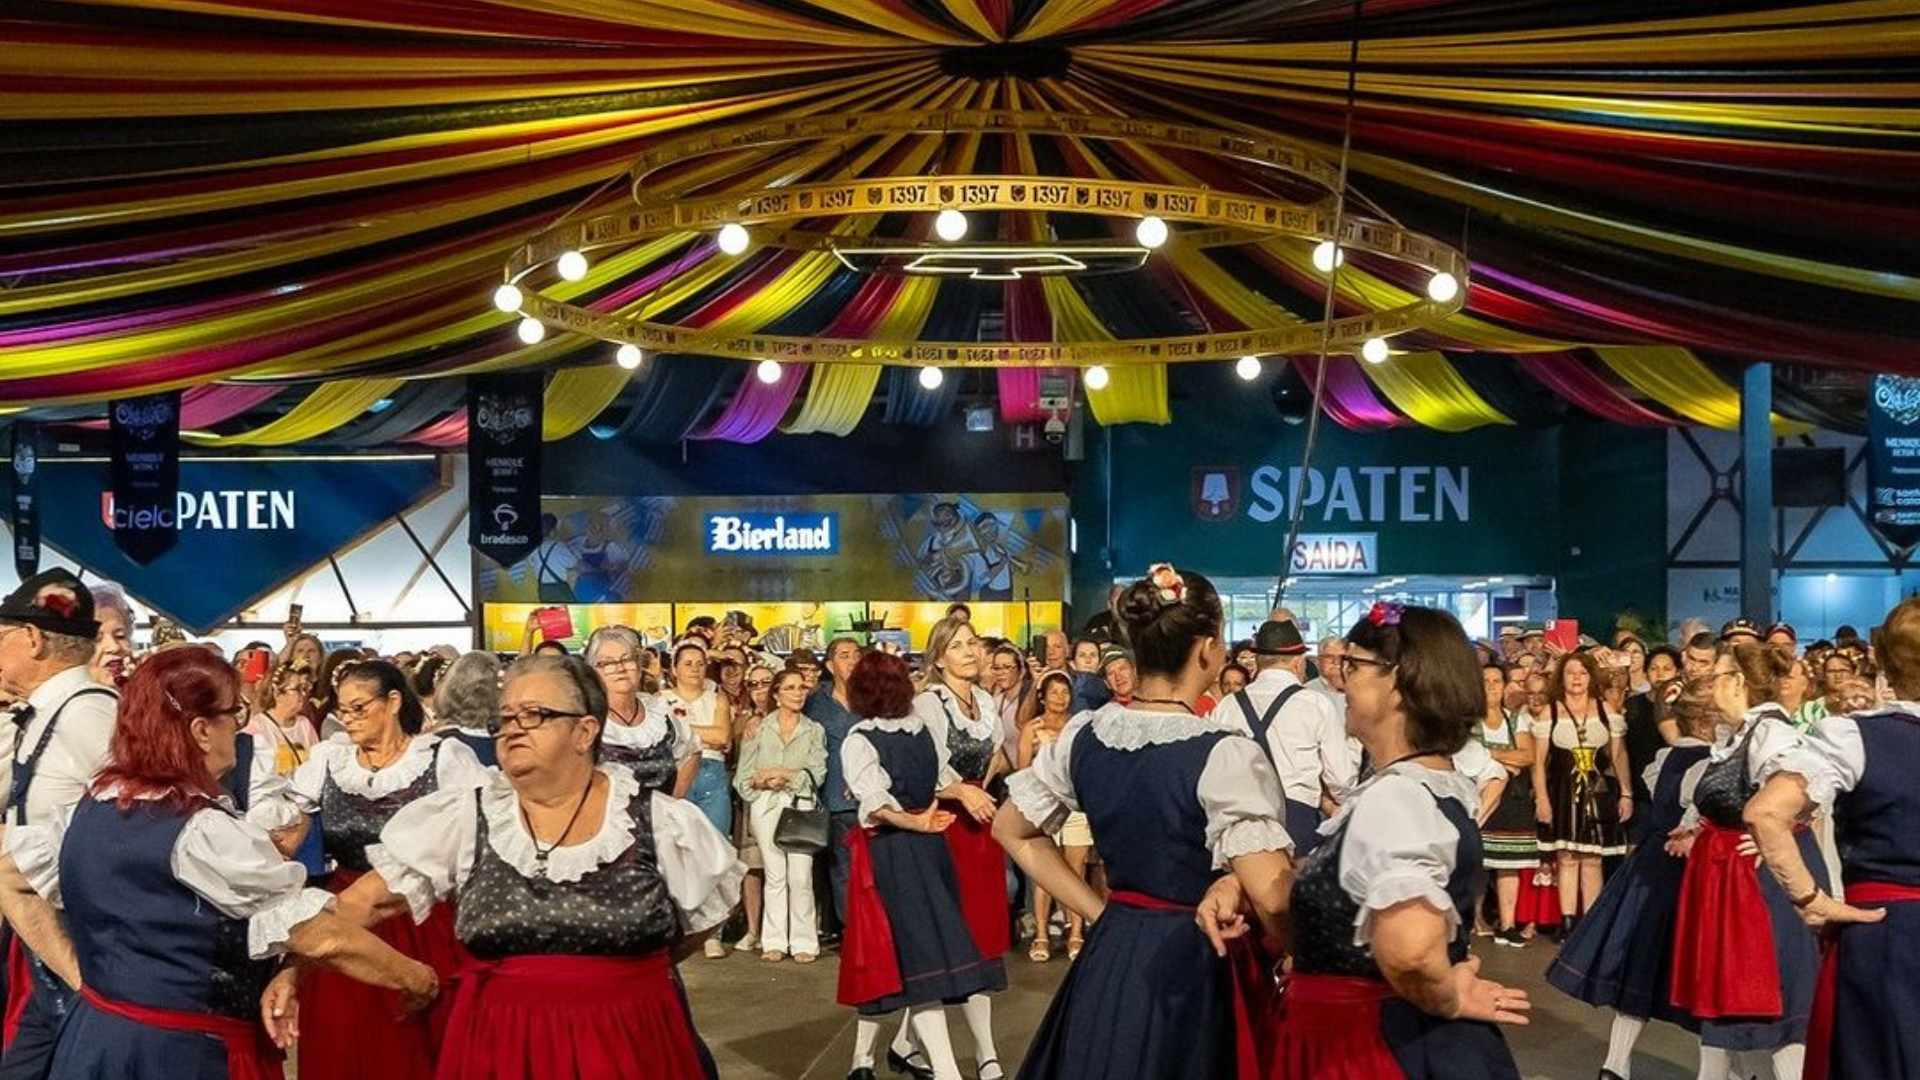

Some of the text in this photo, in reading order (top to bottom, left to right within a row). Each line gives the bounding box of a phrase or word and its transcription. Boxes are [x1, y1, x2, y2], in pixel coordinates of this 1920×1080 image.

[757, 194, 790, 215] 1397
[819, 189, 855, 208] 1397
[888, 186, 927, 204] 1397
[960, 185, 999, 205] 1397
[1032, 186, 1069, 204] 1397
[1095, 189, 1132, 208] 1397
[1163, 193, 1197, 213] 1397
[1226, 203, 1256, 221] 1397
[177, 490, 294, 529] PATEN
[1247, 466, 1469, 522] SPATEN
[481, 532, 528, 545] bradesco
[711, 516, 831, 551] Bierland
[1293, 537, 1368, 570] SAÍDA
